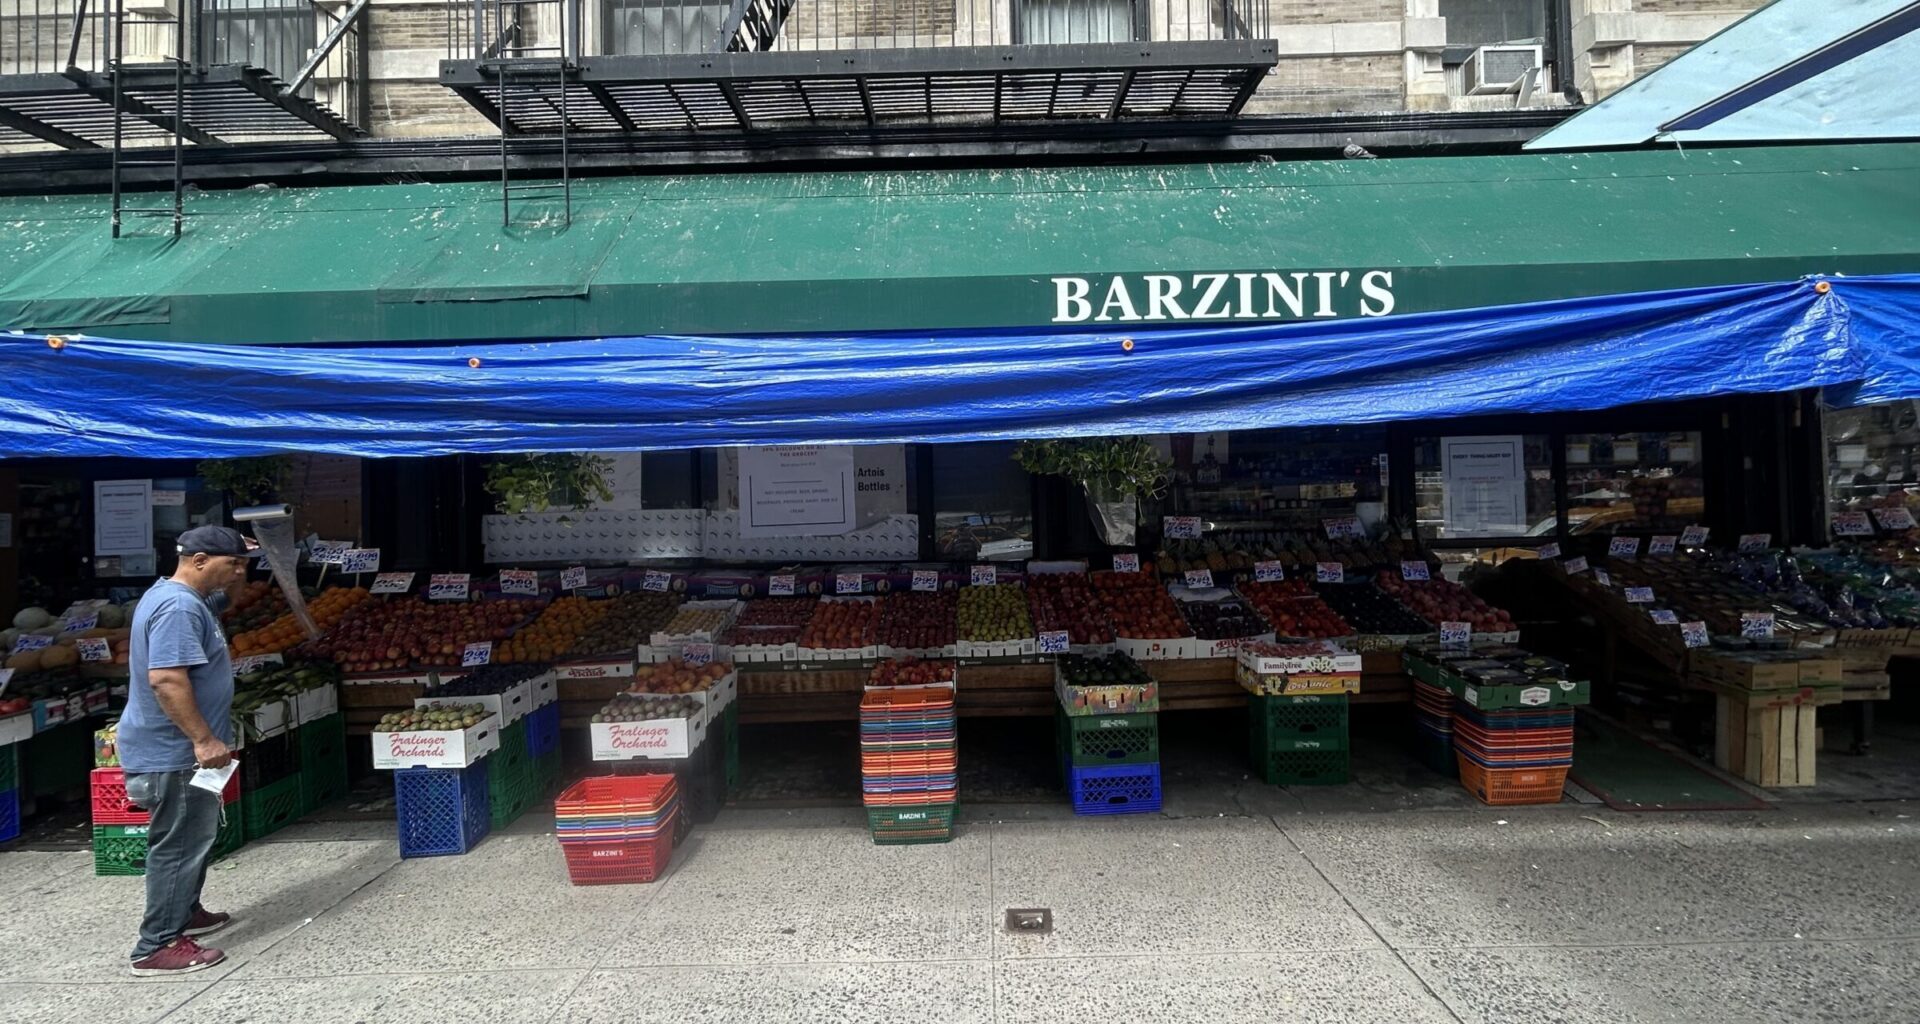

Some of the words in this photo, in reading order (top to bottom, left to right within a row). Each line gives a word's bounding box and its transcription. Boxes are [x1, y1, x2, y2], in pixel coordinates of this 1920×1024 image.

[1051, 270, 1396, 323] BARZINI'S
[857, 467, 886, 477] Artois
[857, 481, 891, 492] Bottles
[608, 724, 670, 738] Fralinger
[388, 733, 447, 747] Fralinger
[612, 736, 669, 749] Orchards
[391, 745, 446, 757] Orchards
